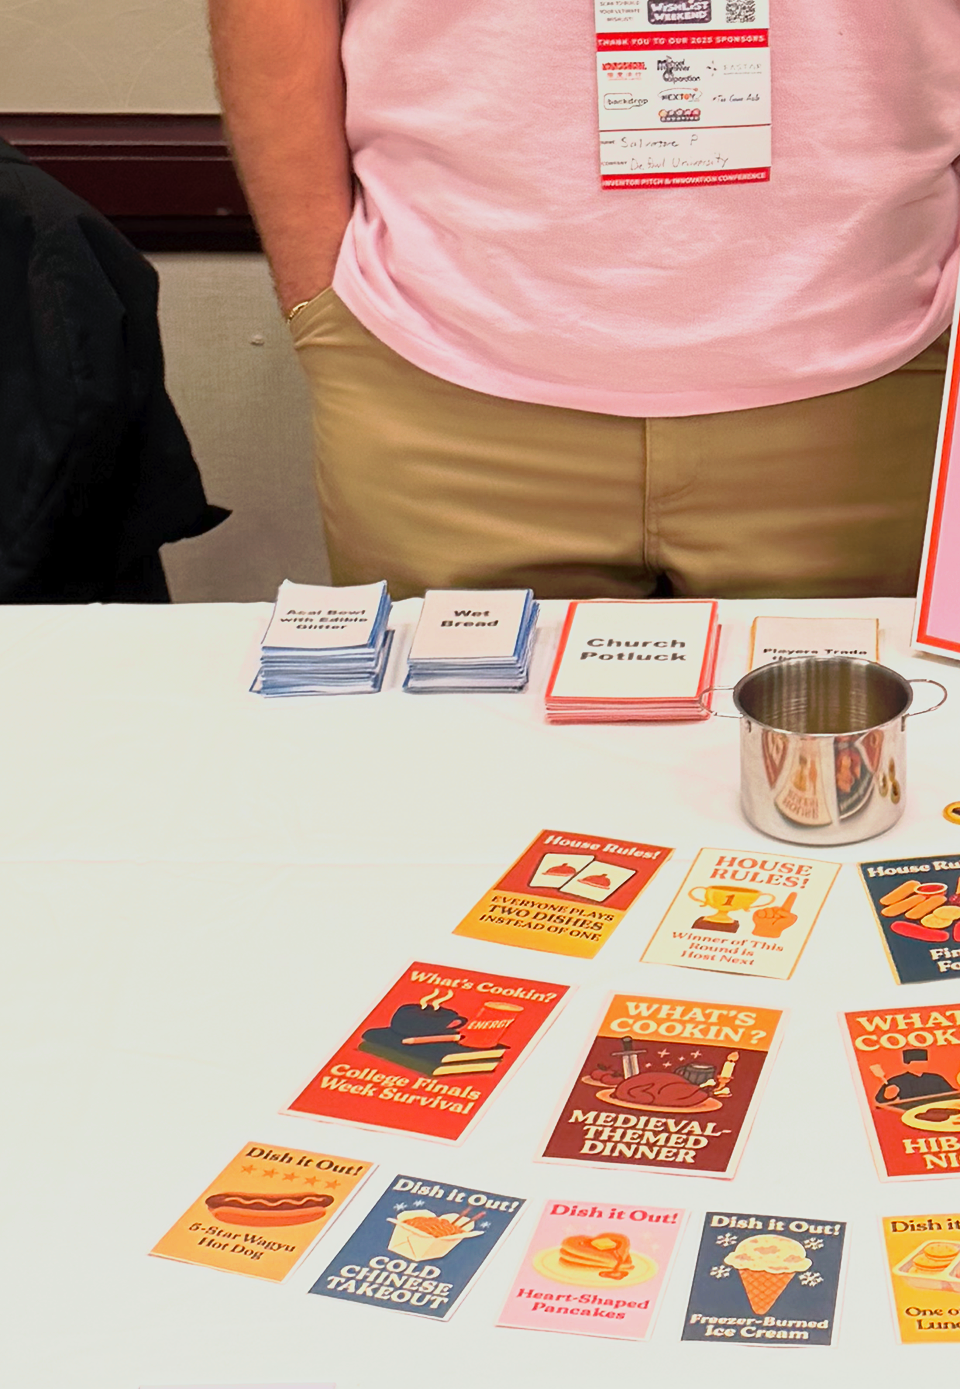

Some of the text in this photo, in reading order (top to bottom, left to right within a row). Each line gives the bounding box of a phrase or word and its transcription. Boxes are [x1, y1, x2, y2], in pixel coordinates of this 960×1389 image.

[440, 619, 499, 628] Bread
[453, 609, 490, 617] Wet
[586, 638, 686, 649] Church
[580, 651, 686, 662] Potluck
[544, 835, 662, 861] House Rules!
[715, 855, 813, 877] HOUSE
[709, 868, 809, 889] RULES!
[488, 904, 604, 932] TWO DISHES
[492, 895, 614, 923] EVERYONE PLAYS
[479, 914, 601, 942] INSTEAD OF ONE
[410, 970, 557, 1004] What's Cookin?
[467, 1018, 514, 1031] ENERGY
[330, 1063, 482, 1101] College Finals
[320, 1076, 476, 1116] Week Survival
[568, 1109, 733, 1138] MEDIEVAL-
[582, 1125, 709, 1150] THEMED
[245, 1146, 364, 1177] Dish it Out!
[579, 1140, 697, 1164] DINNER
[188, 1222, 297, 1253] 5-Star Wagyu
[710, 1214, 842, 1237] Dish it Out!
[197, 1237, 265, 1261] Hot Dog
[369, 1255, 441, 1280] COLD
[327, 1275, 450, 1310] TAKEOUT
[340, 1264, 454, 1297] CHINESE
[516, 1287, 651, 1311] Heart-Shaped
[531, 1302, 626, 1321] Pancakes
[690, 1313, 829, 1330] Freezer-Burned
[705, 1324, 809, 1341] Ice Cream
